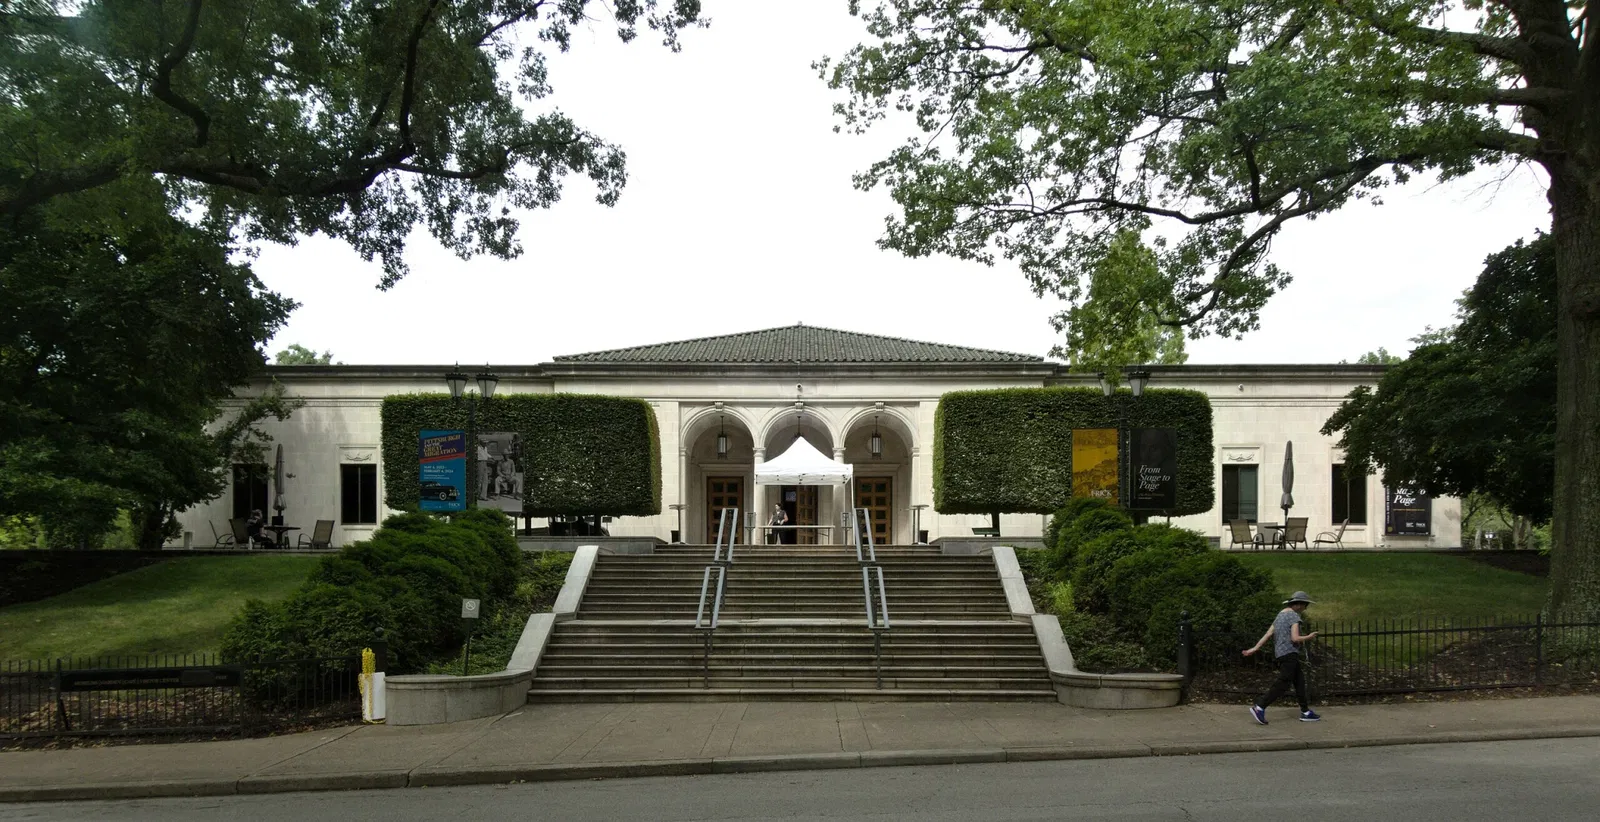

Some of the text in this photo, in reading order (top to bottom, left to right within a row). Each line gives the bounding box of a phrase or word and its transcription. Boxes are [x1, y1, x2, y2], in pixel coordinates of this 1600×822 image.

[424, 434, 461, 445] PITTSBURGH
[424, 447, 457, 457] MIGRATION
[1139, 464, 1161, 474] From
[1138, 472, 1171, 483] Stage to
[1139, 480, 1160, 492] Page
[1393, 494, 1416, 506] Page
